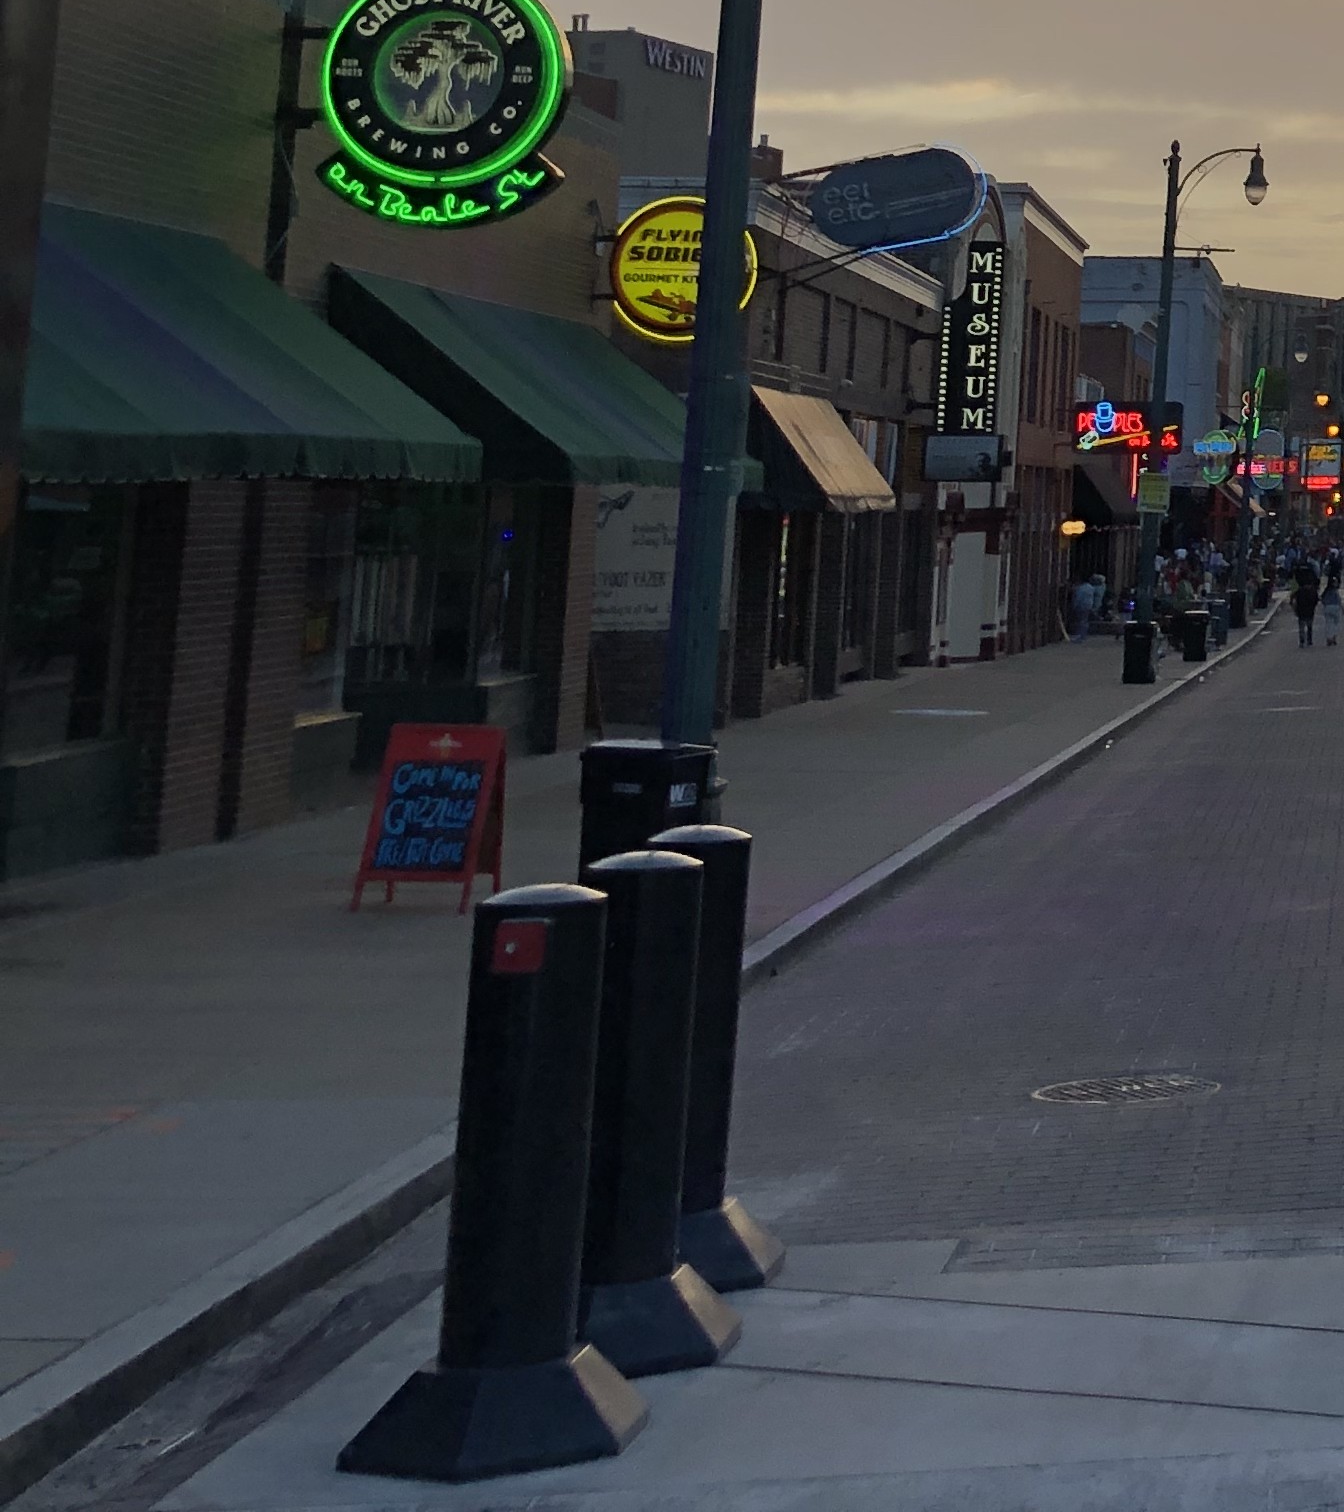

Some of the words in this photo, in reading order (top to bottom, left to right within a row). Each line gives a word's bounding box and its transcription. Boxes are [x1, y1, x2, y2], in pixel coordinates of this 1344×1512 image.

[645, 39, 707, 80] WESTIN
[347, 98, 471, 159] BREWING
[489, 99, 523, 136] CO.
[378, 183, 491, 223] Beale
[497, 168, 547, 210] St
[629, 245, 702, 262] SOBIE
[641, 228, 703, 242] FLYIN
[623, 272, 680, 284] GOURMET
[682, 274, 699, 284] KIT
[961, 250, 995, 430] MUSEUM
